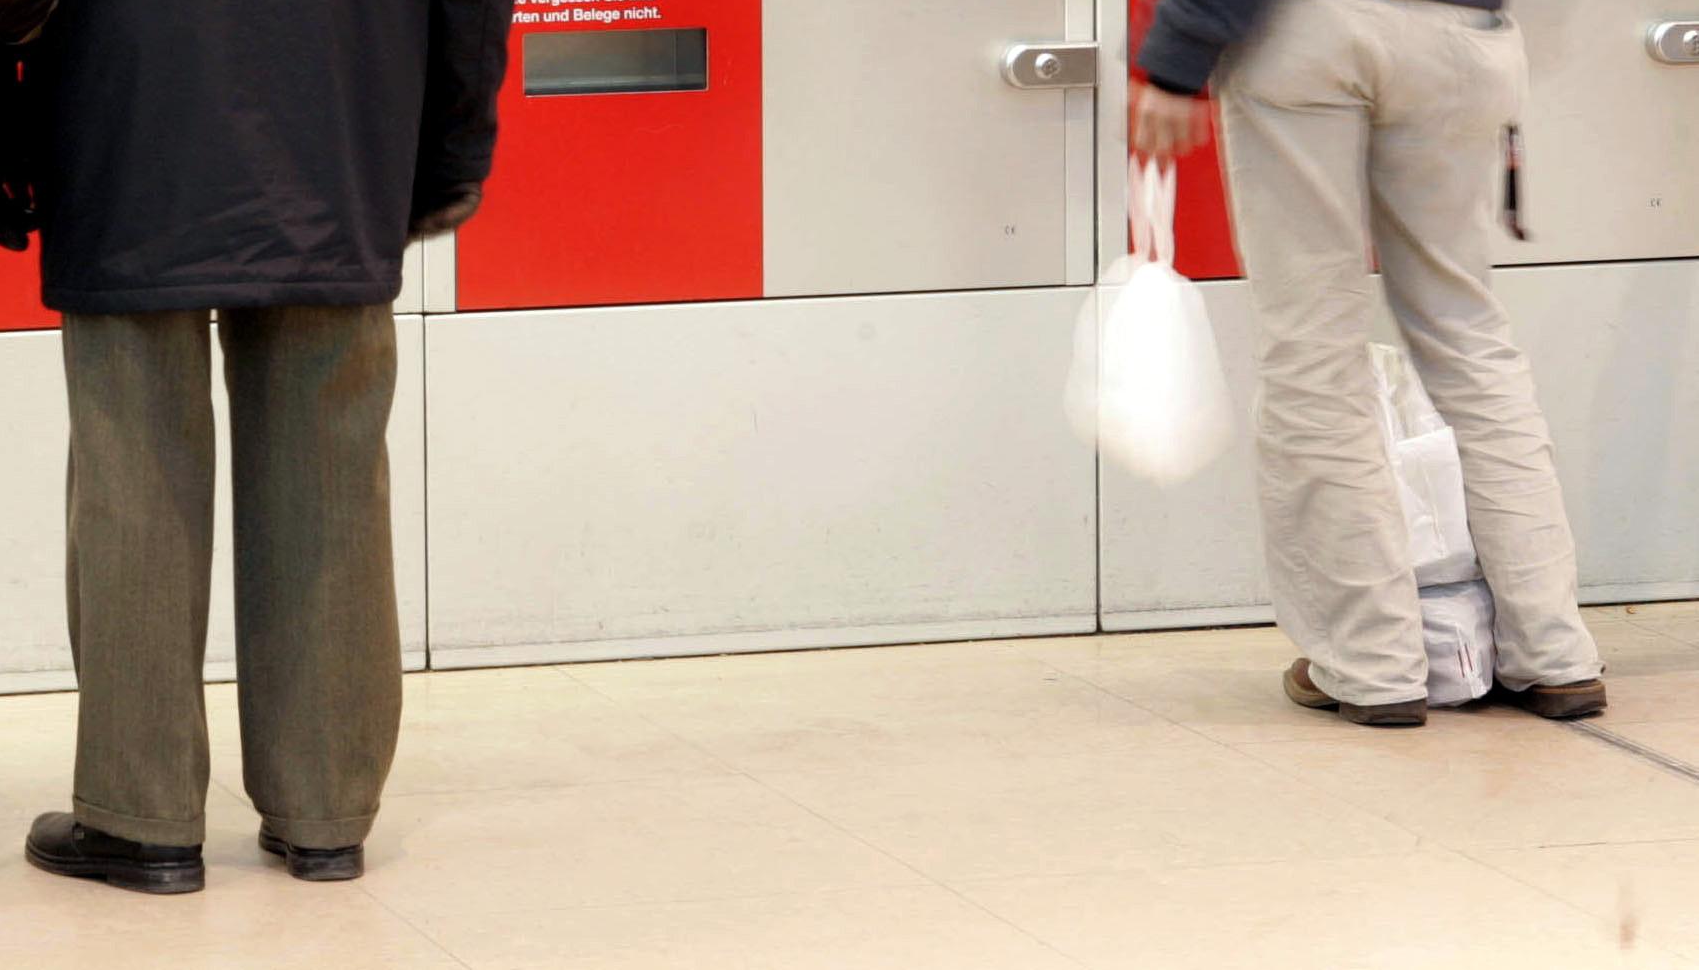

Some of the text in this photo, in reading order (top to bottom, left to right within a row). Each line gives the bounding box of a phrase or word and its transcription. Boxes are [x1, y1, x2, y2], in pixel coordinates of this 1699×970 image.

[543, 9, 569, 22] und
[573, 9, 620, 23] Belege
[624, 6, 662, 20] nicht.
